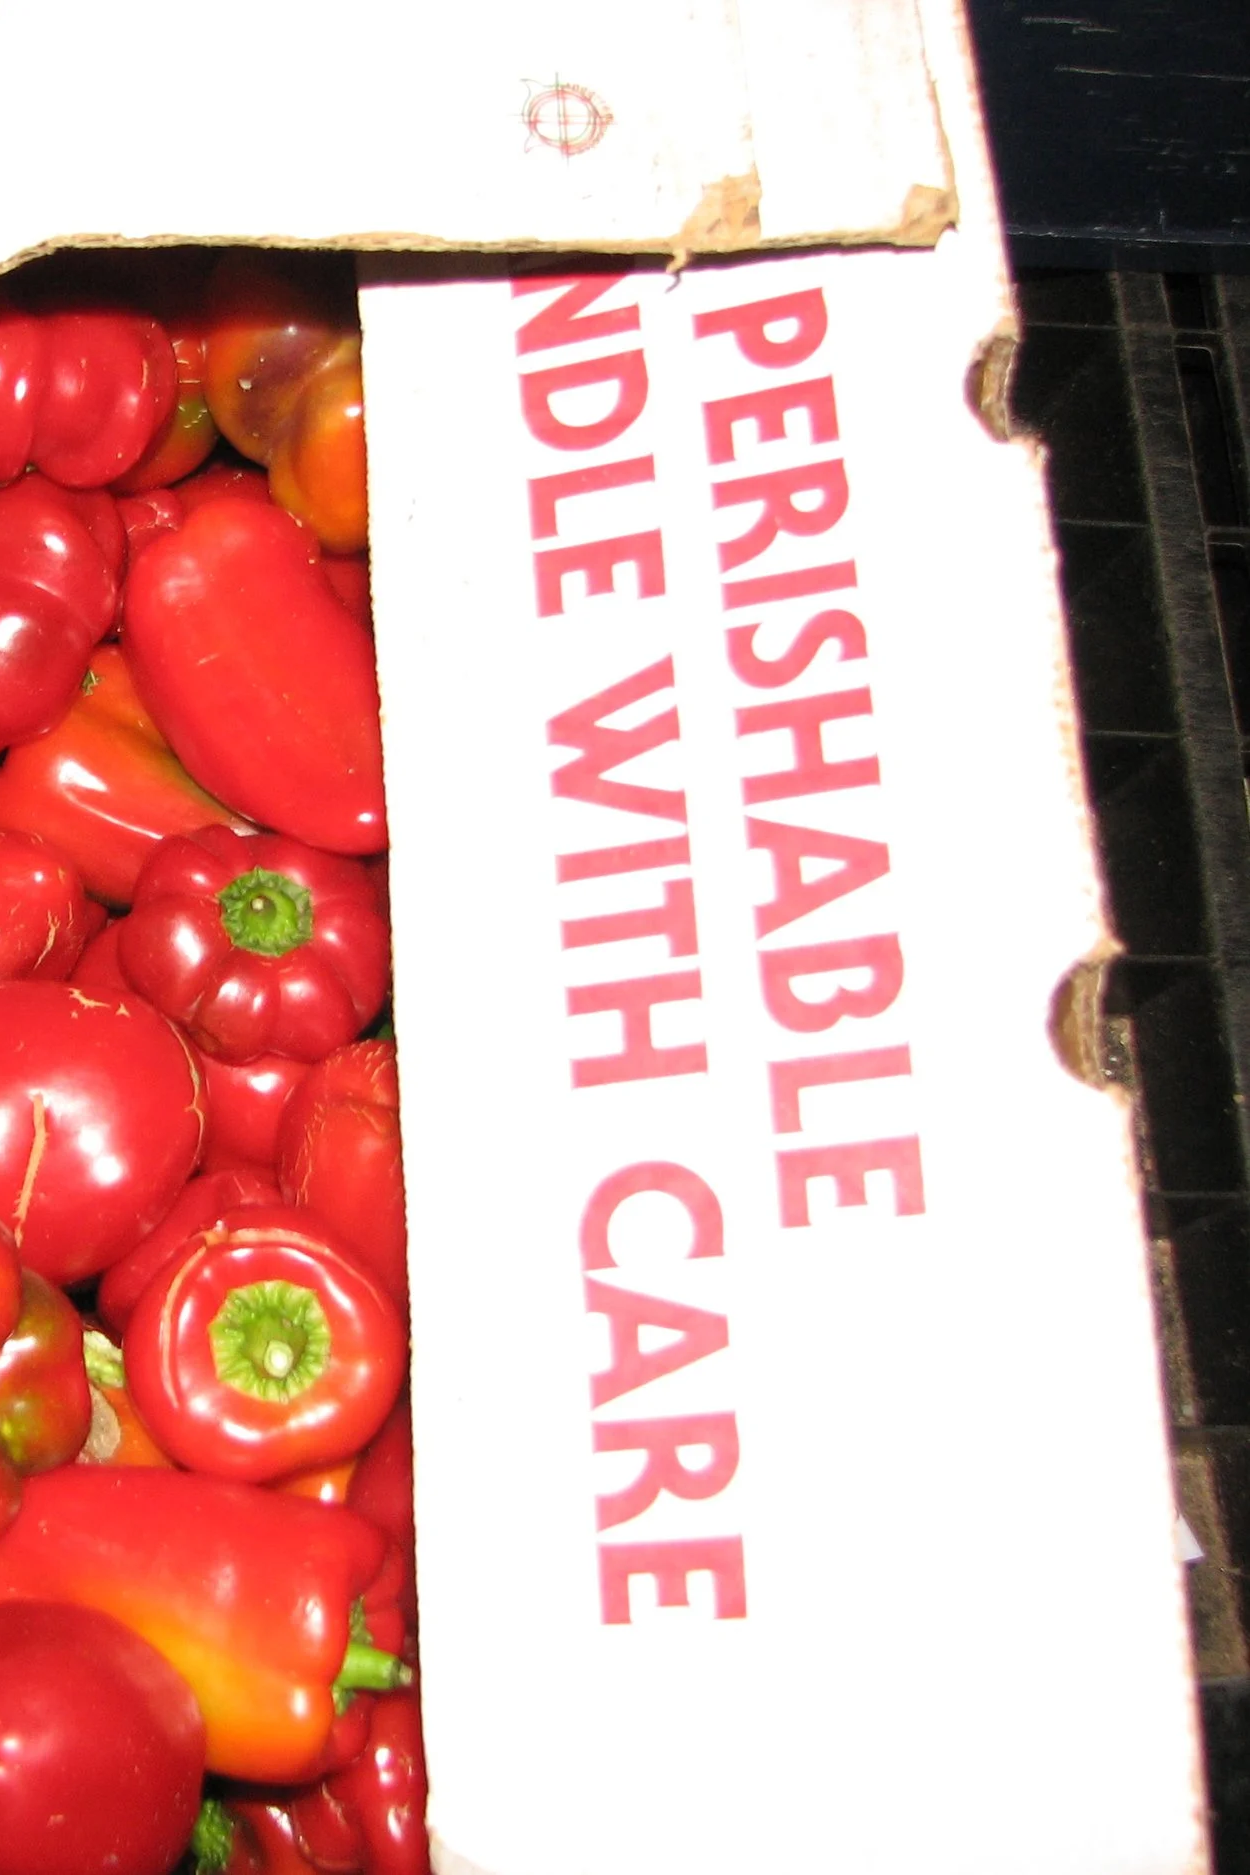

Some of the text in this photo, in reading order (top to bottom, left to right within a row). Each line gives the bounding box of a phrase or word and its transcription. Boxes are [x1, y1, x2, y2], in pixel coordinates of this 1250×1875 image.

[508, 253, 665, 616] NDLE
[549, 655, 707, 1087] WITH
[695, 287, 923, 1227] PERISHABLE
[582, 1161, 748, 1625] CARE
